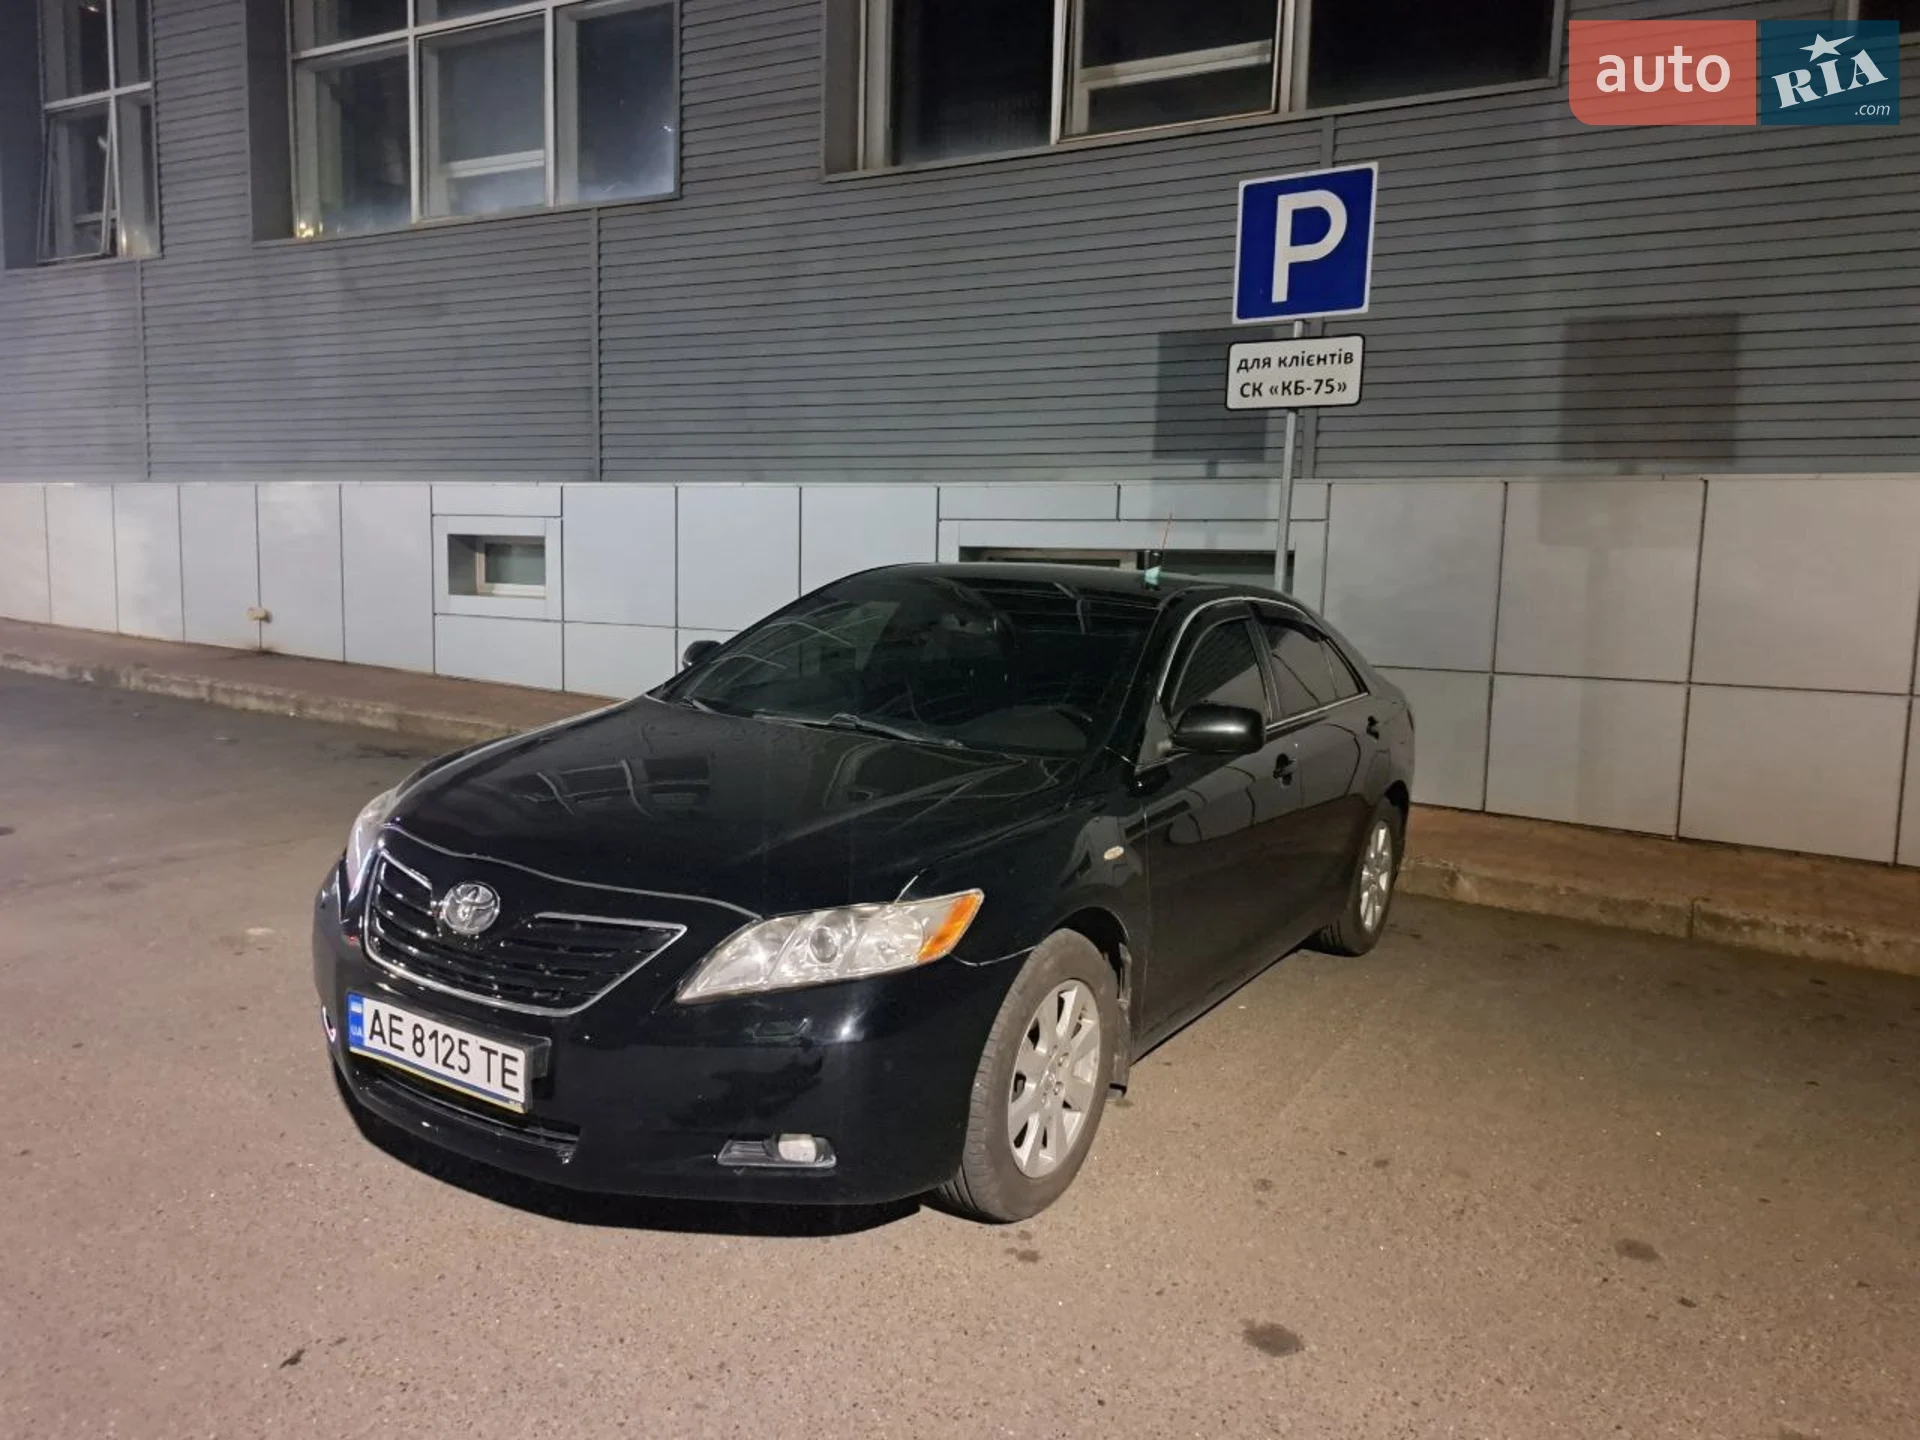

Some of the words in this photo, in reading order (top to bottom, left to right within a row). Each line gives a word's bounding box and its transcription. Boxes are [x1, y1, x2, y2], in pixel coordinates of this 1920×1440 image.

[1271, 189, 1348, 303] P
[1236, 356, 1272, 373] для
[1278, 348, 1354, 368] клієнтів
[1240, 382, 1263, 398] СК
[1269, 378, 1347, 396] «КБ-75»
[350, 1024, 363, 1037] UA
[369, 1008, 405, 1052] AE
[412, 1022, 471, 1075] 8125
[479, 1044, 520, 1093] TE
